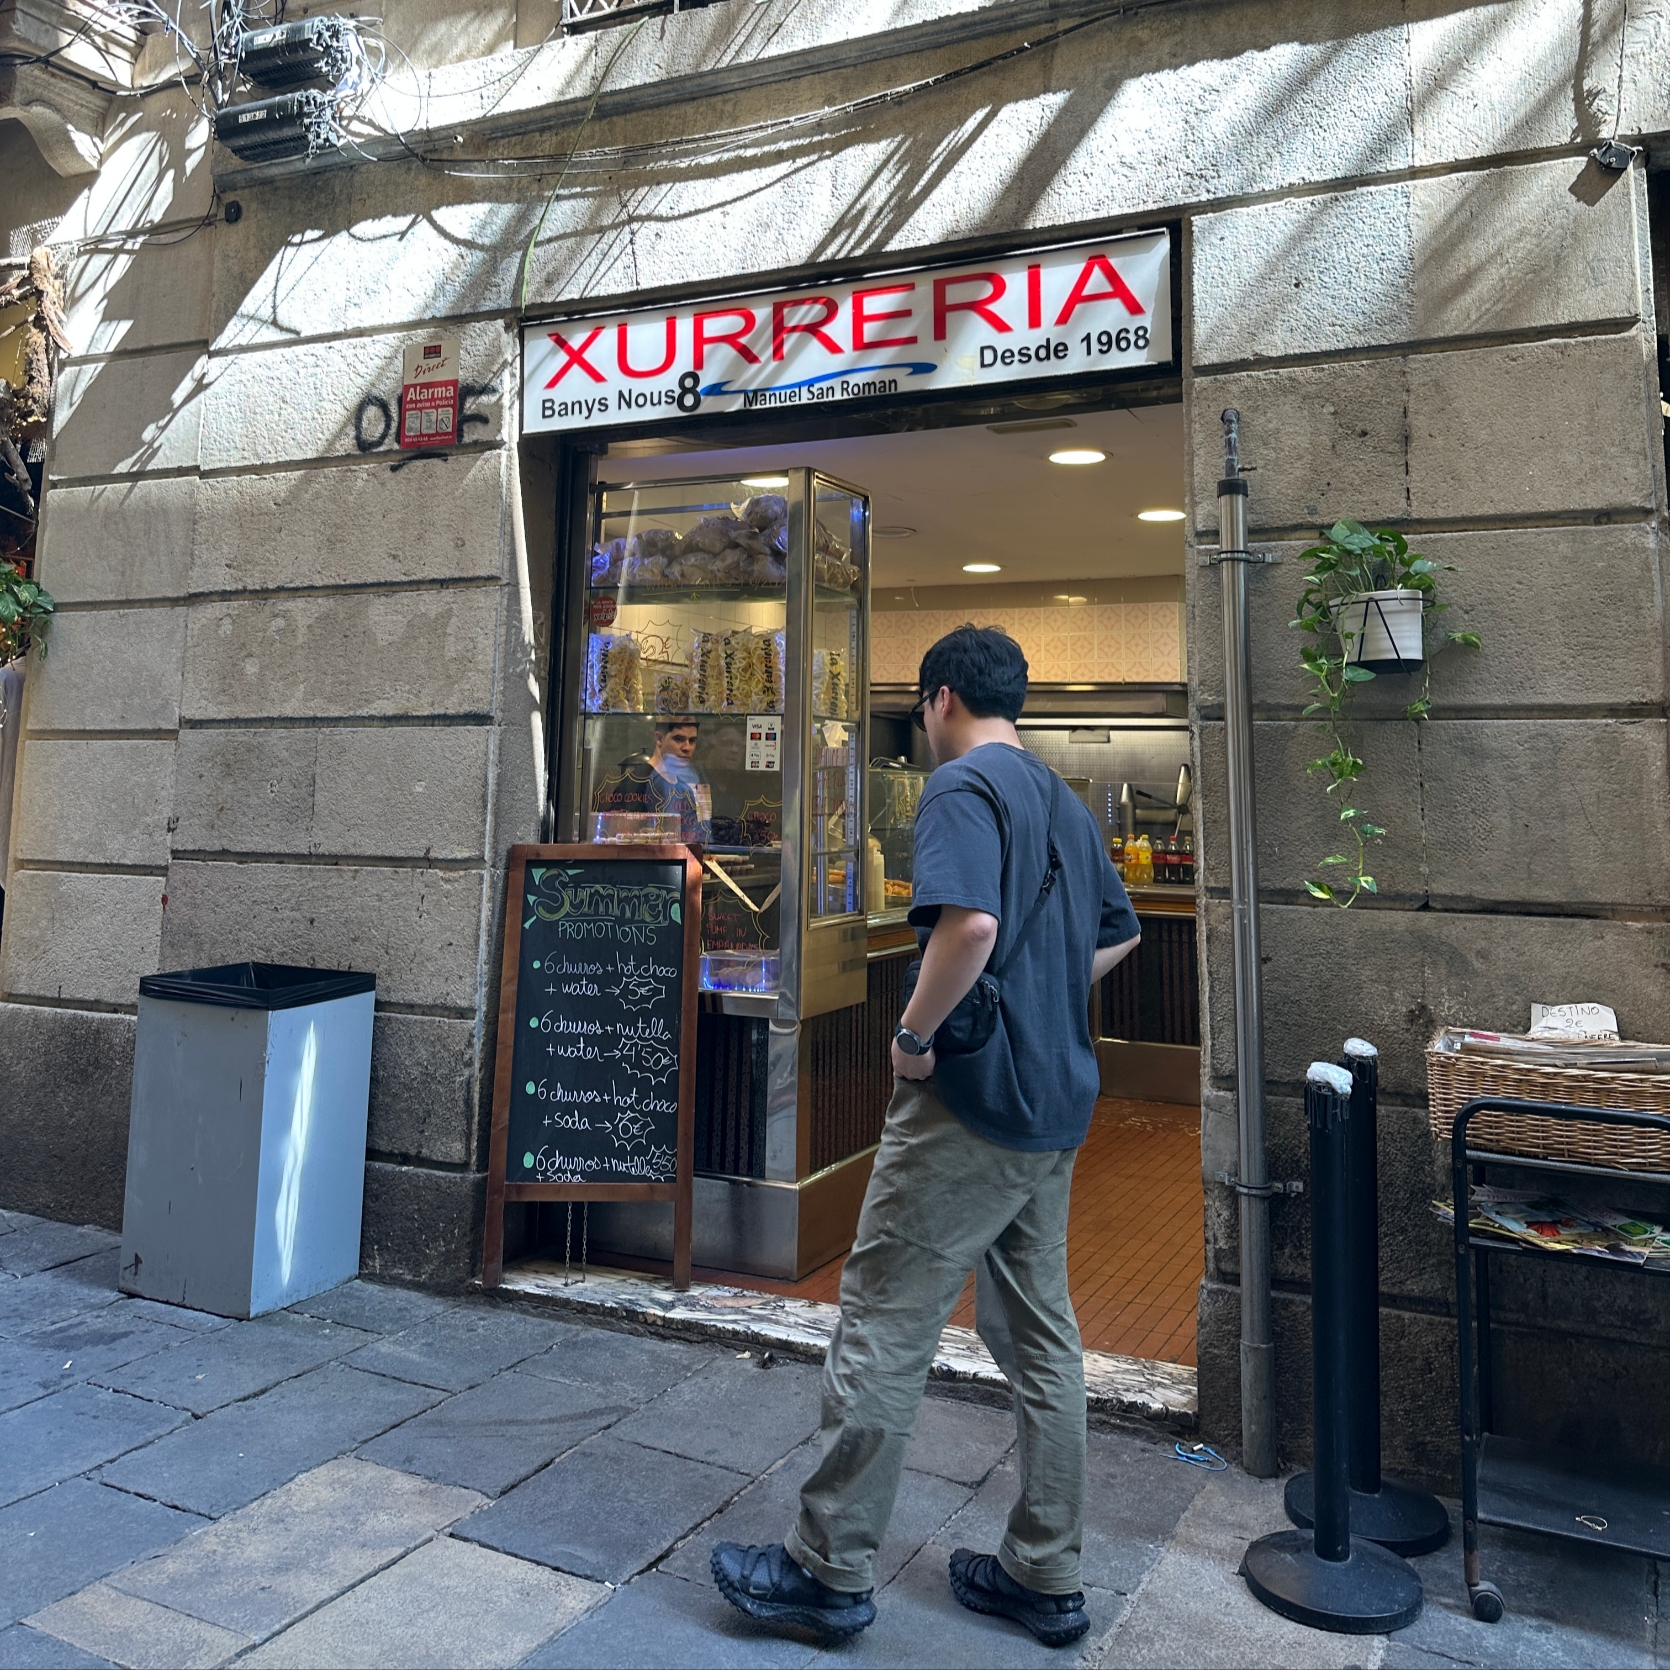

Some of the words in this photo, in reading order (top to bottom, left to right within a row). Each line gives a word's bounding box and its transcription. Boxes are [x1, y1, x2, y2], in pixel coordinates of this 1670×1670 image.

[543, 254, 1146, 390] XURRERIA
[979, 338, 1069, 369] Desde
[1080, 326, 1150, 357] 1968
[414, 357, 451, 379] Direct
[406, 385, 454, 401] Alarma
[541, 396, 609, 420] Banys
[617, 387, 677, 411] Nous
[676, 371, 700, 413] 8
[743, 384, 802, 408] Manuel
[807, 382, 835, 401] San
[841, 377, 898, 398] Roman
[534, 868, 680, 926] Summer
[558, 921, 657, 945] PROMOTIONS
[616, 951, 640, 975] hot
[640, 957, 677, 978] choco
[561, 977, 601, 996] water
[627, 981, 654, 1000] 5€
[1541, 1005, 1600, 1018] DESTINO
[616, 1016, 672, 1041] nutella
[642, 1091, 678, 1113] choco
